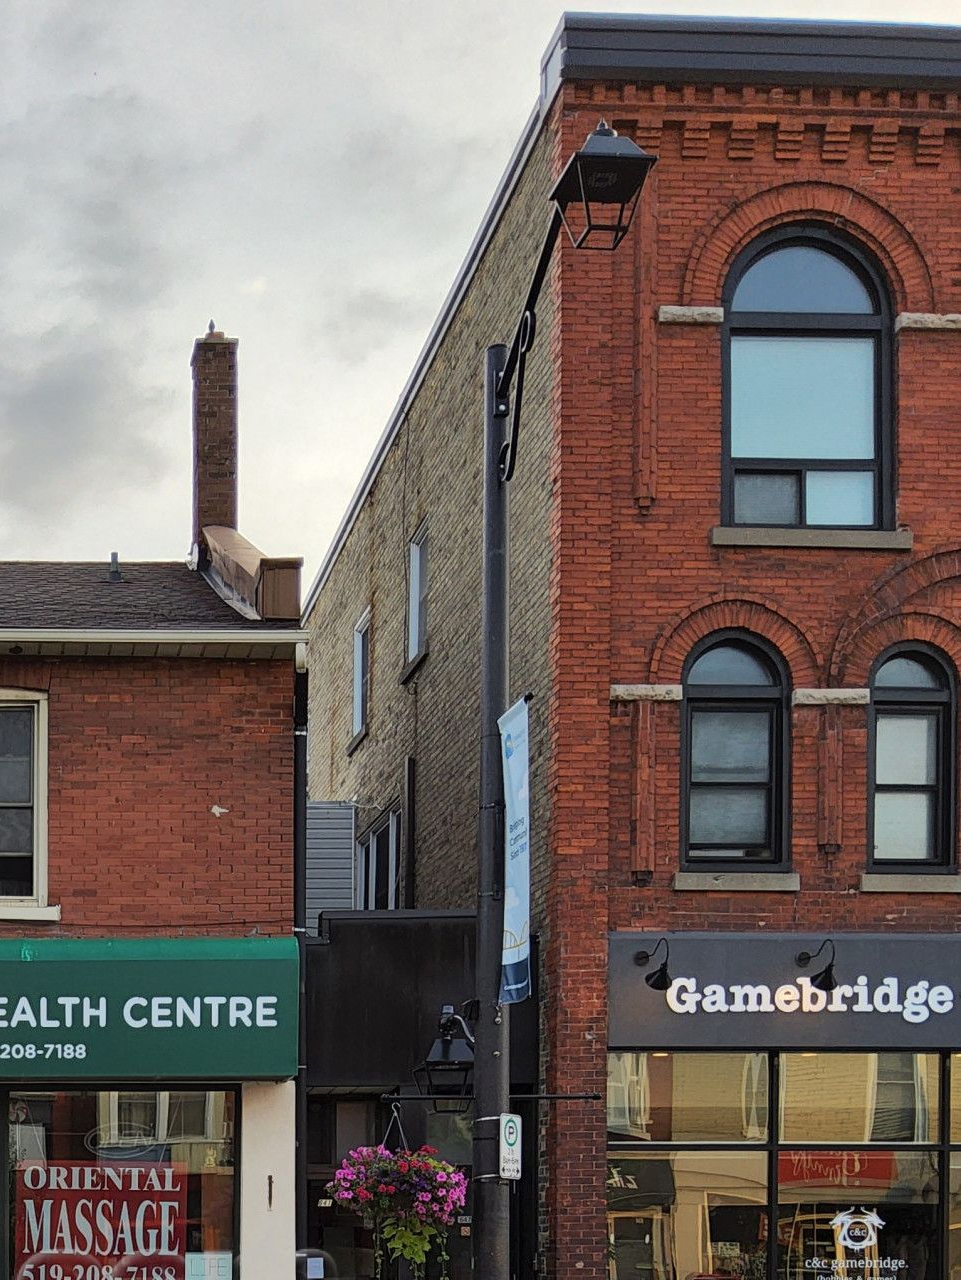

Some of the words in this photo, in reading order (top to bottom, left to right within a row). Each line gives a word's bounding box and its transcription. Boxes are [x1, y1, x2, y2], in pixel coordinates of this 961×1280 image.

[123, 996, 278, 1028] CENTRE
[665, 976, 954, 1024] Gamebridge
[23, 1165, 181, 1192] ORIENTAL
[22, 1199, 180, 1257] MASSAGE
[190, 1258, 228, 1277] LIFE
[805, 1257, 828, 1268] c&c
[831, 1256, 909, 1271] gamebridge.
